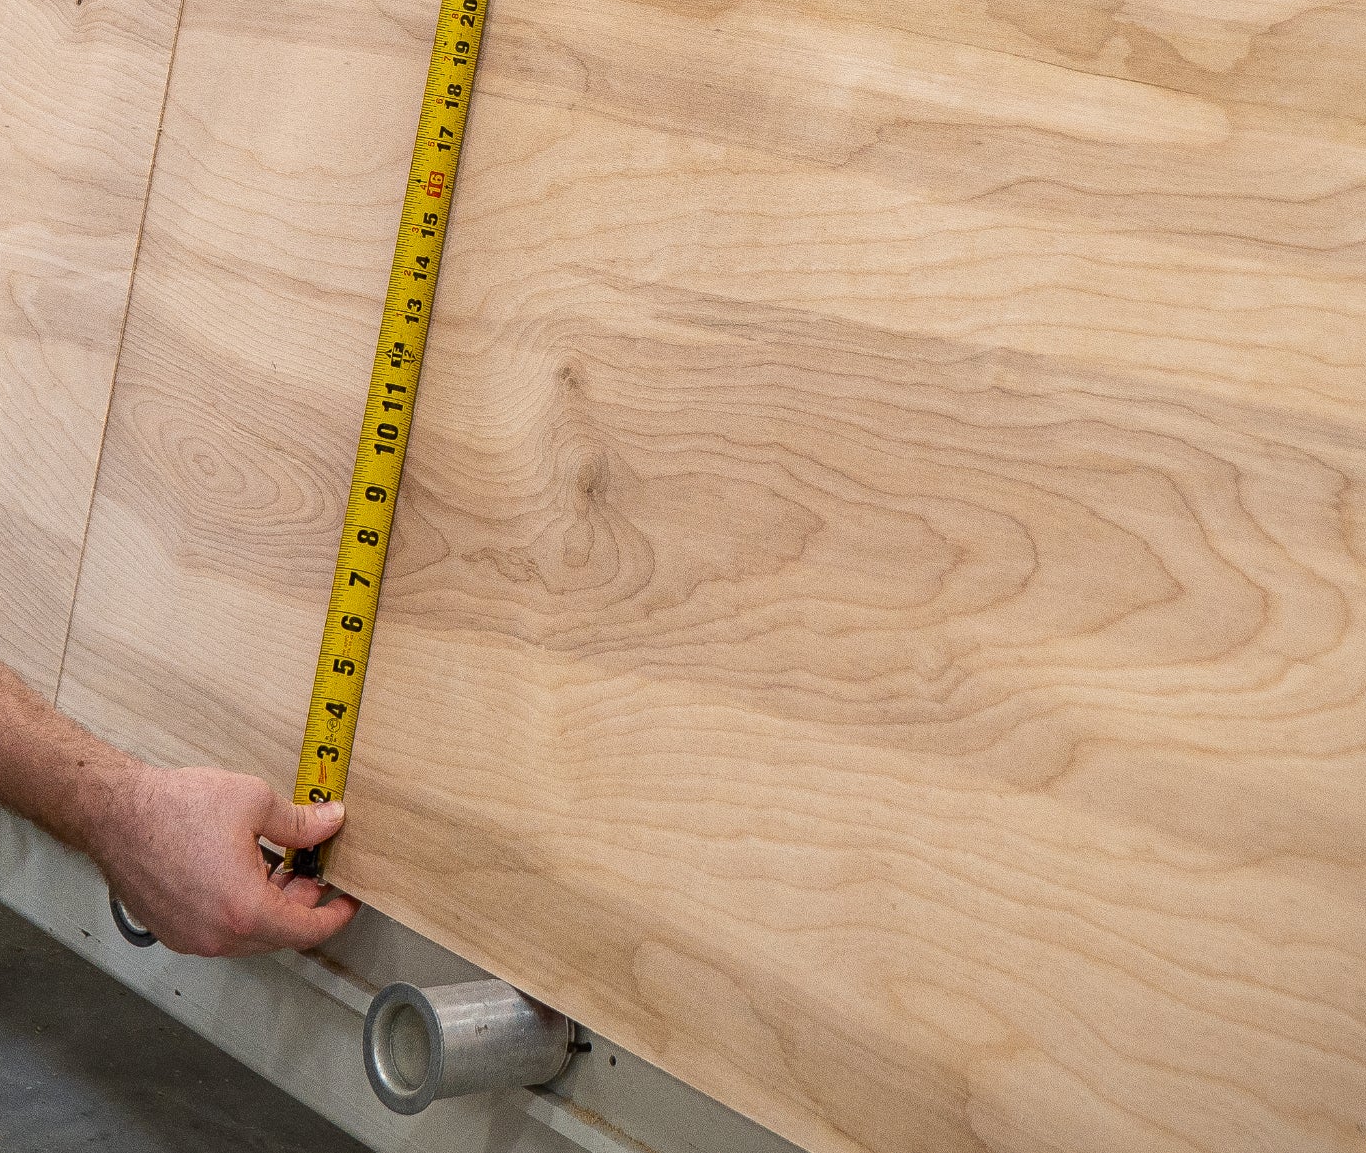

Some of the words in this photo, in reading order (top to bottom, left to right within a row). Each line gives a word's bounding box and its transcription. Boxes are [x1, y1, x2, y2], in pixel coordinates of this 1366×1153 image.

[452, 40, 470, 67] 19
[444, 83, 463, 110] 18
[436, 125, 454, 153] 17
[428, 173, 444, 196] 16
[420, 212, 438, 239] 15
[412, 255, 431, 282] 14
[404, 298, 423, 325] 13
[381, 382, 407, 412] 11
[373, 422, 399, 455] 10
[364, 485, 387, 504] 9
[356, 529, 379, 547] 8
[348, 571, 371, 589] 7
[340, 614, 364, 633] 6
[332, 658, 356, 677] 5
[325, 702, 348, 720] 4
[316, 744, 340, 763] 3
